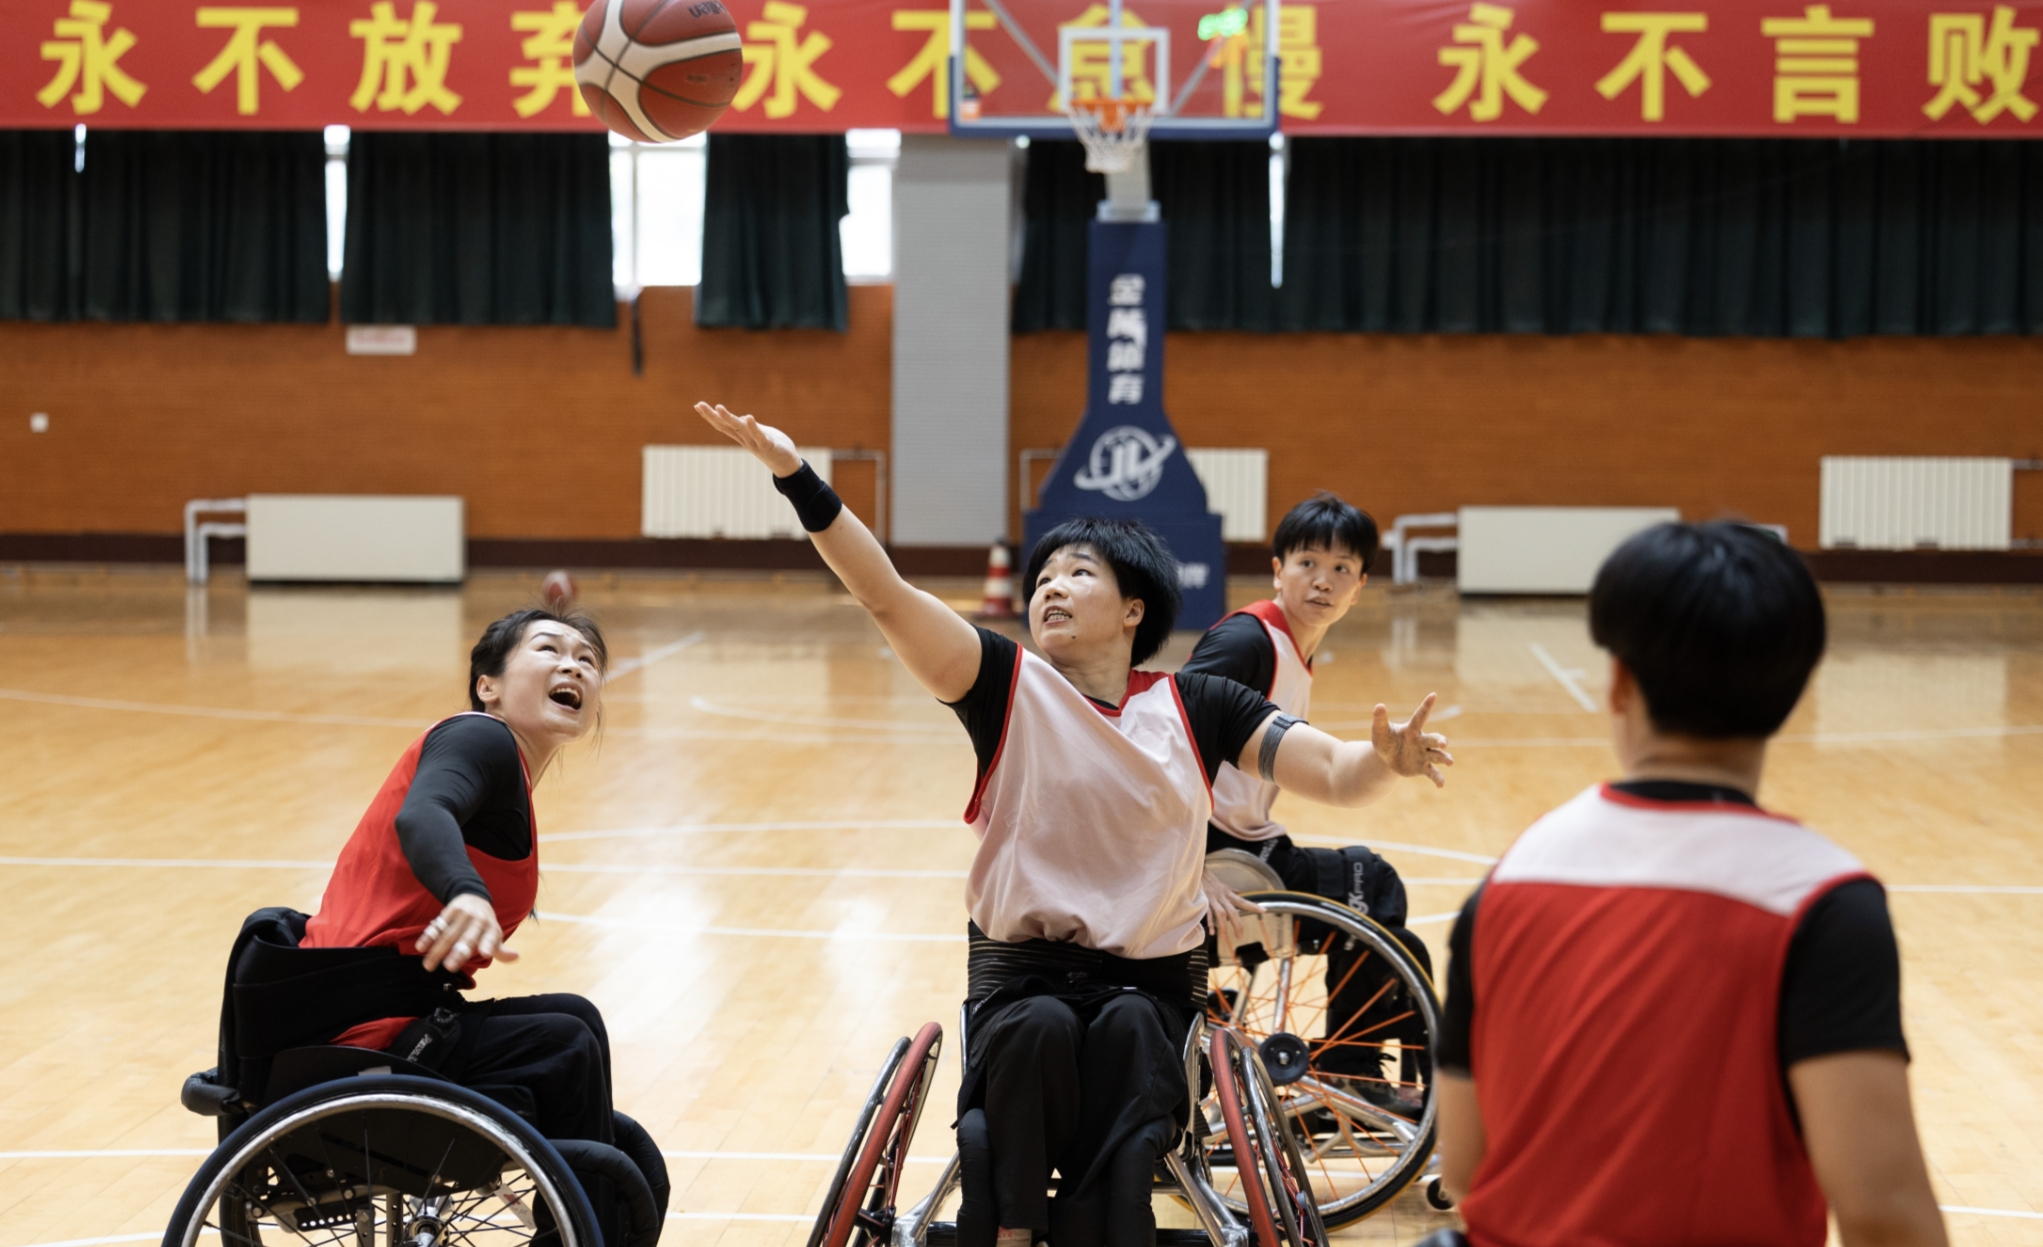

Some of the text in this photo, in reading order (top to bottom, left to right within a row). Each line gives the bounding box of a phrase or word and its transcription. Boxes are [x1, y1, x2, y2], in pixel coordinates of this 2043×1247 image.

[36, 0, 592, 117] 永不放弃
[1432, 2, 2040, 125] 永不言败
